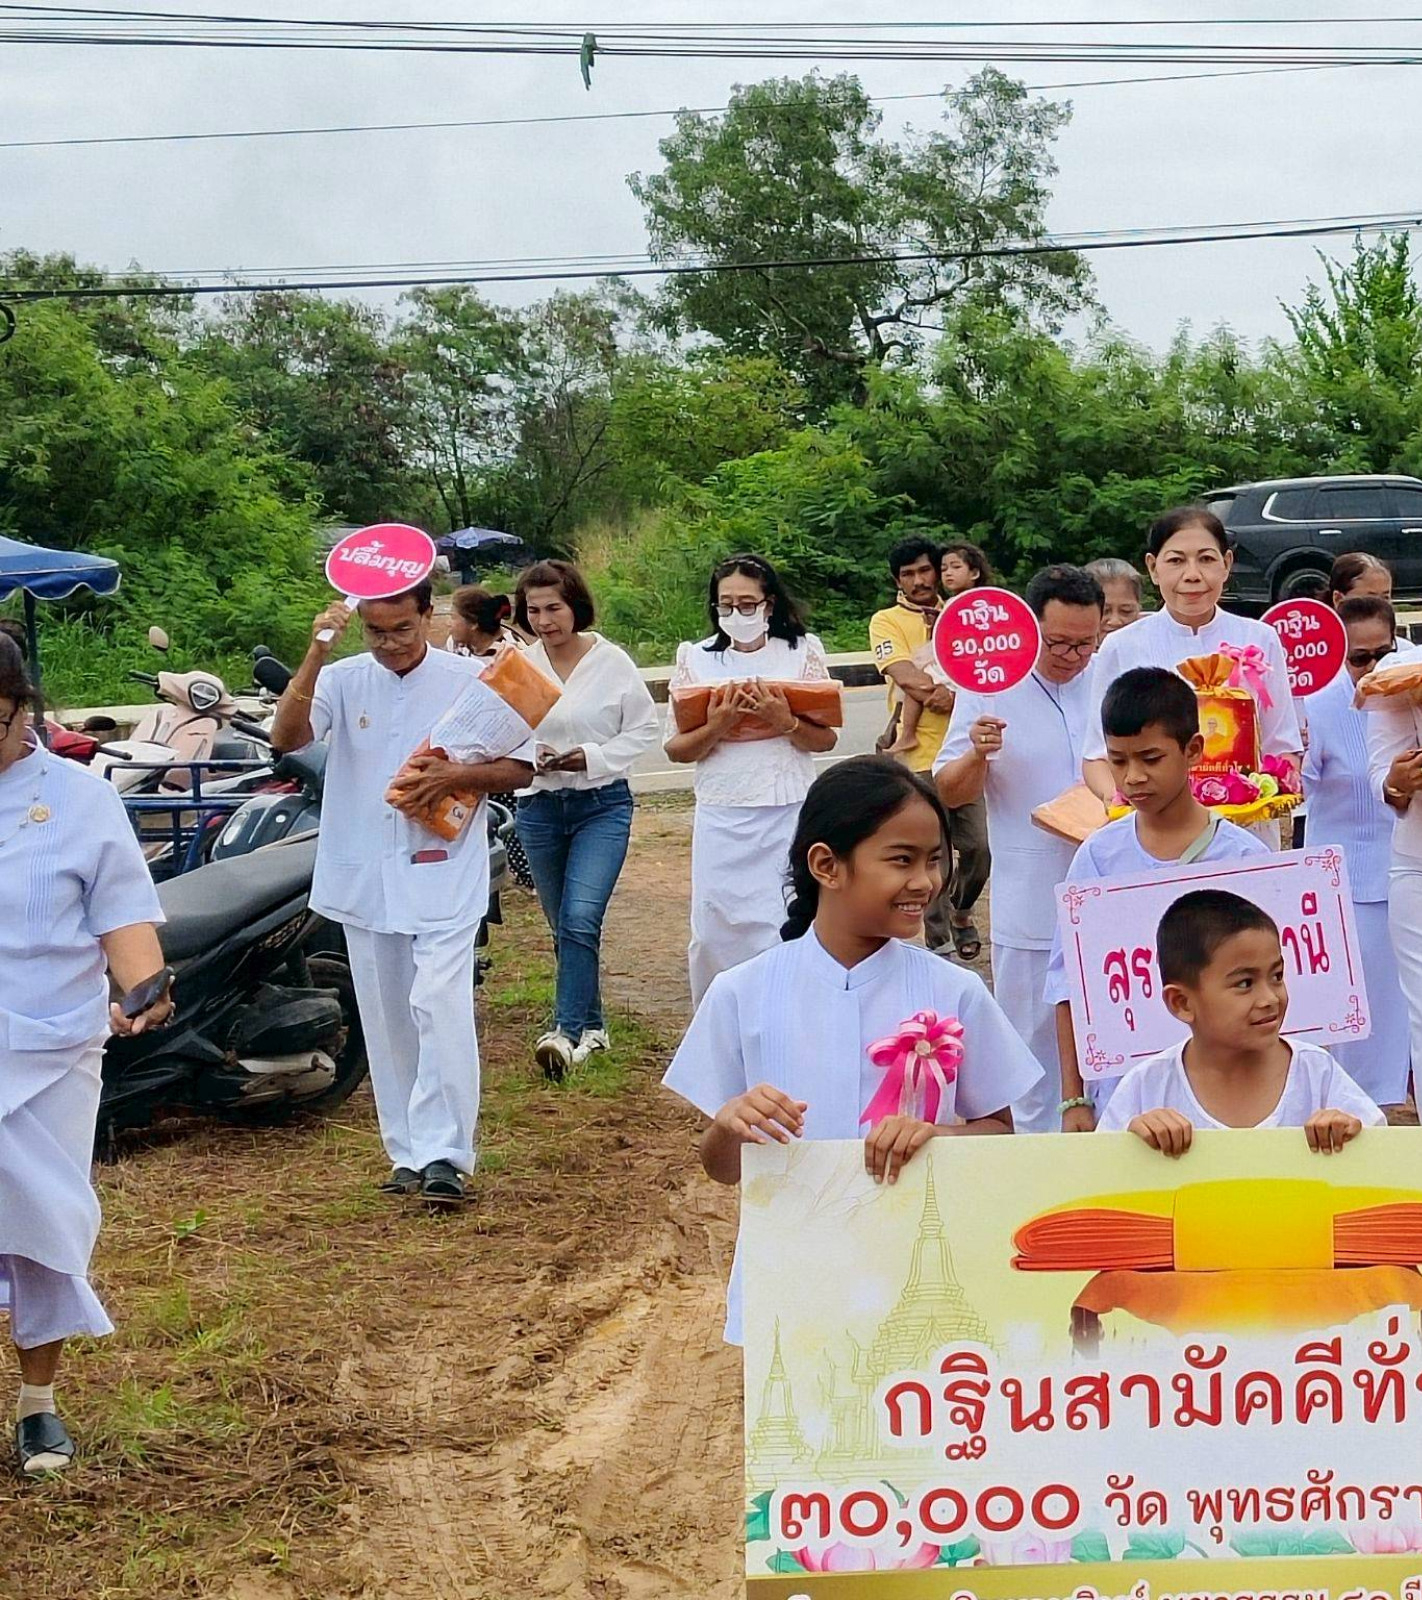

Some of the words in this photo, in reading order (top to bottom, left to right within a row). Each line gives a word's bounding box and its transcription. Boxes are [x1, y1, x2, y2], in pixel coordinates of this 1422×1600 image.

[339, 540, 424, 579] ปลื้มบุญ
[958, 600, 1009, 630] กฐิน
[1273, 610, 1320, 639] กฐิน
[952, 633, 1020, 656] 30,000
[973, 660, 1005, 685] วัด
[780, 1483, 1080, 1547] ๓๐,๐๐๐
[1104, 1474, 1168, 1527] วัด
